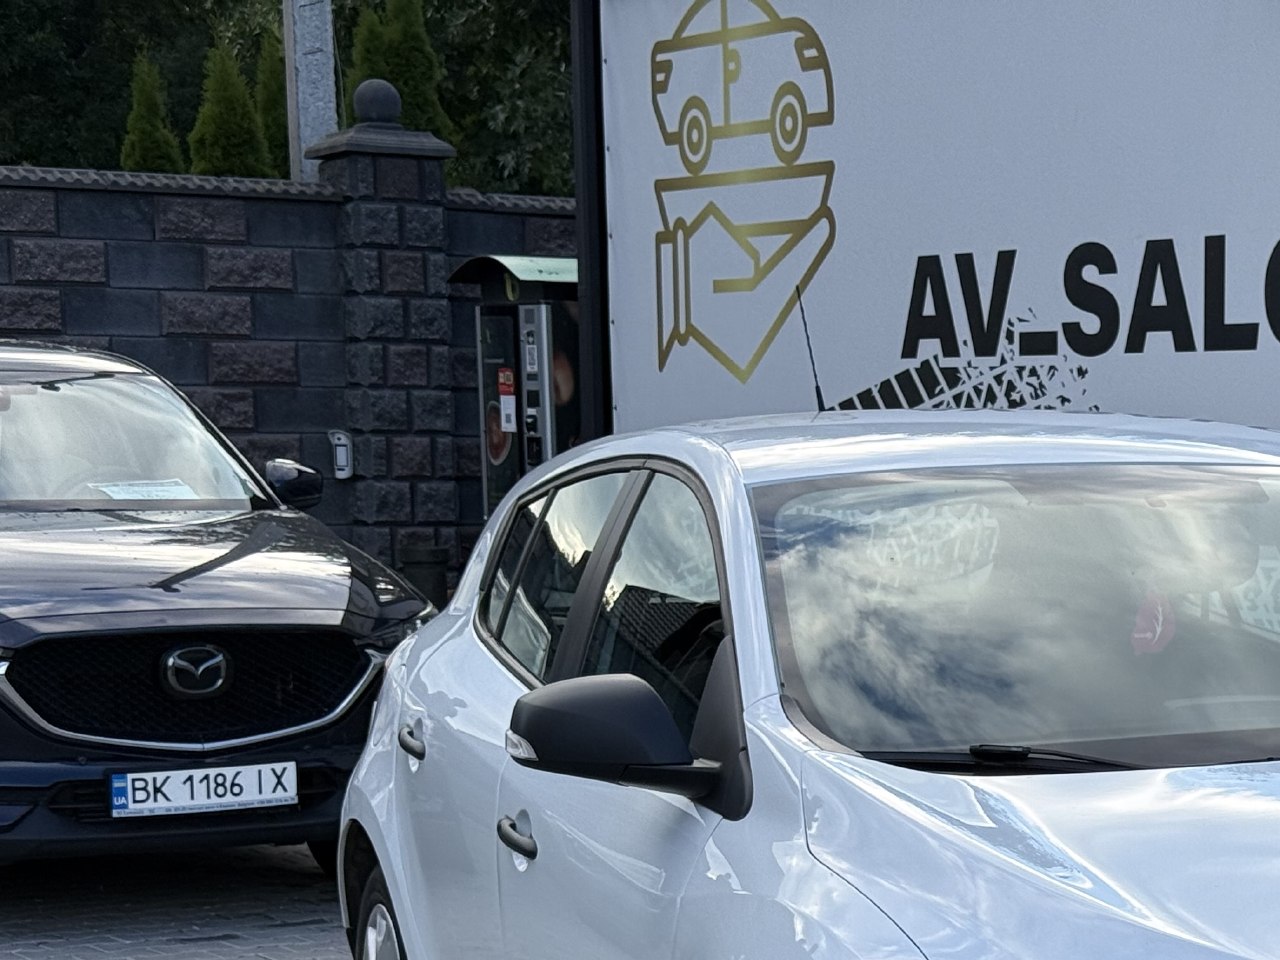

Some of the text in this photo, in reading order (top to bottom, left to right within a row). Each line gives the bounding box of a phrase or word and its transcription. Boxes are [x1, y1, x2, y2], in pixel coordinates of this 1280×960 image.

[130, 766, 288, 804] BK 1186 IX
[114, 796, 127, 806] UA
